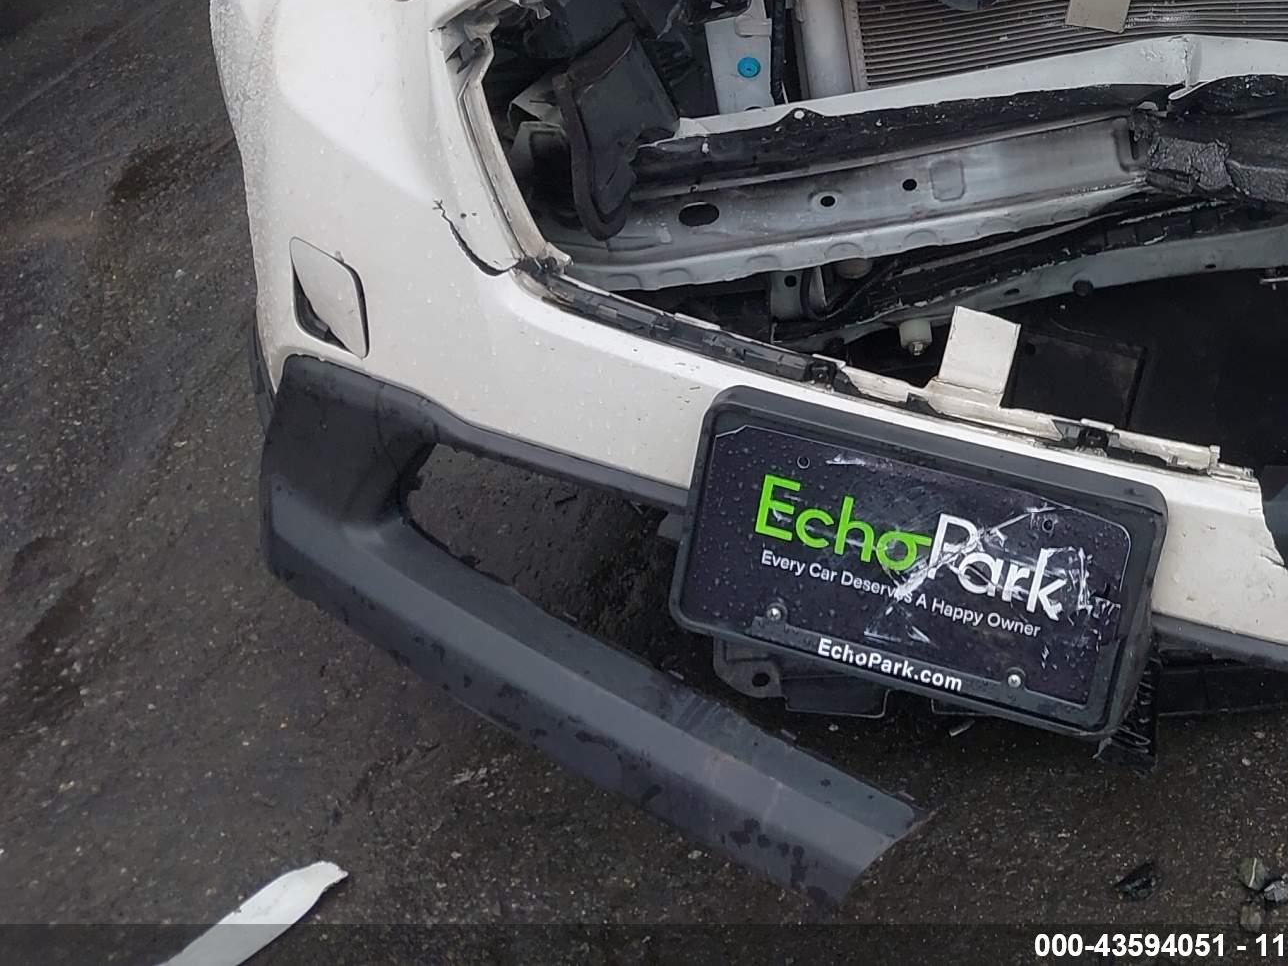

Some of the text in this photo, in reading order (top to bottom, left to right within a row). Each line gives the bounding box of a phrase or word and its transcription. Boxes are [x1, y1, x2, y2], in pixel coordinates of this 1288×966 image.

[754, 474, 1068, 622] EchoPark
[761, 549, 806, 576] Every
[809, 562, 838, 582] Car
[915, 593, 928, 610] A
[931, 597, 984, 627] Happy
[987, 612, 1041, 638] Owner
[817, 637, 963, 691] EchoPark.com
